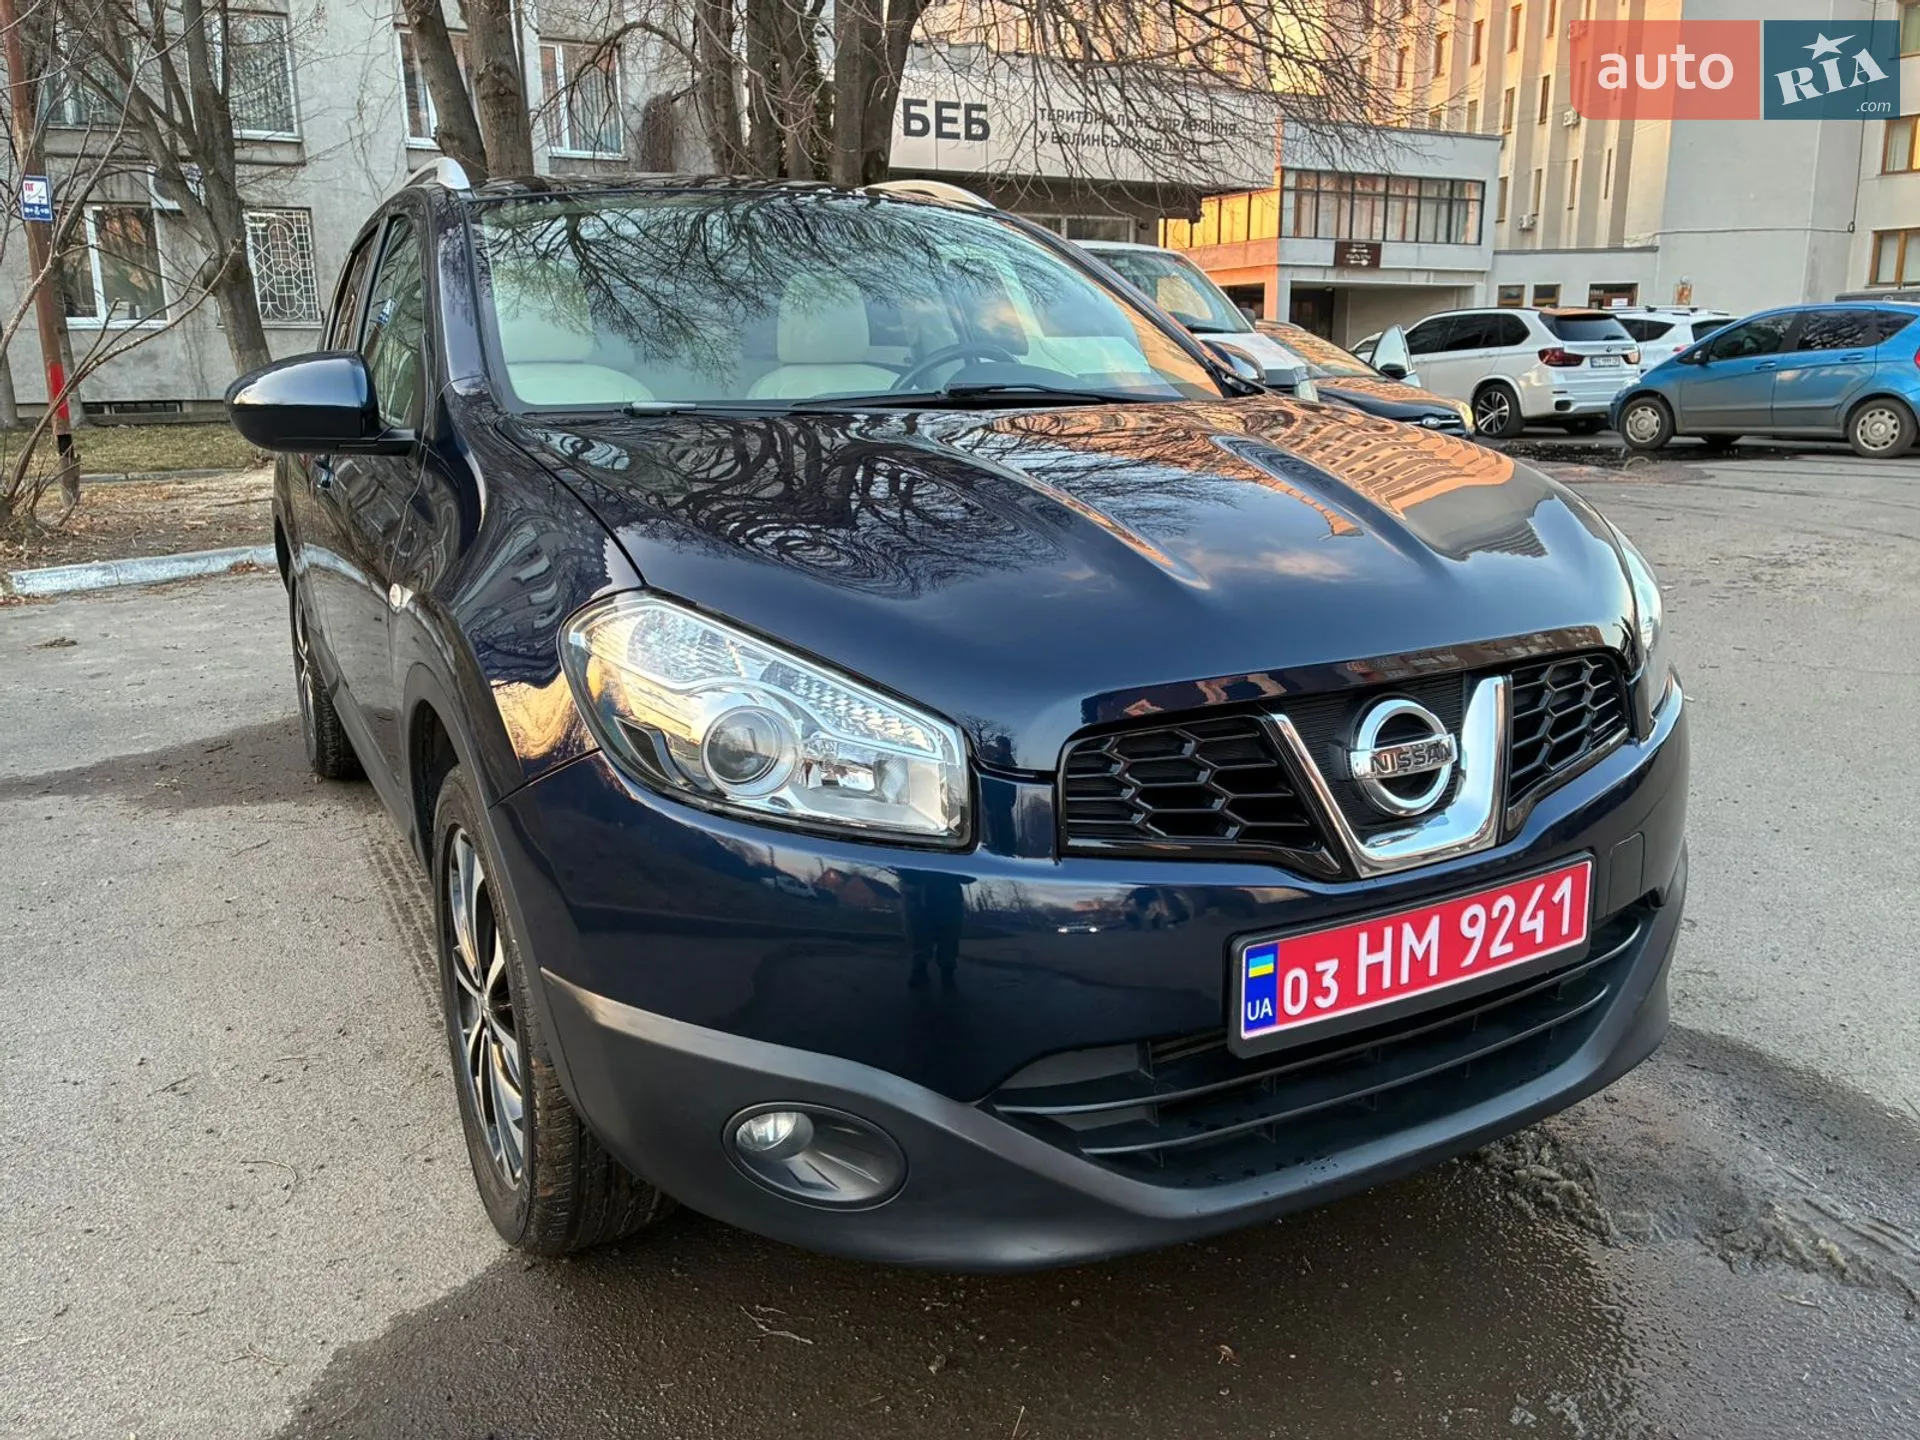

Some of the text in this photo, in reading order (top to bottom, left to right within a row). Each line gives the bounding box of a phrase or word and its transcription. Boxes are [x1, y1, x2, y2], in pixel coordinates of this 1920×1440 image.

[902, 97, 990, 141] БЕБ
[1039, 130, 1048, 144] У
[1369, 740, 1453, 773] NISSAN
[1282, 875, 1573, 1016] 03 HM 9241
[1247, 997, 1273, 1022] UA
